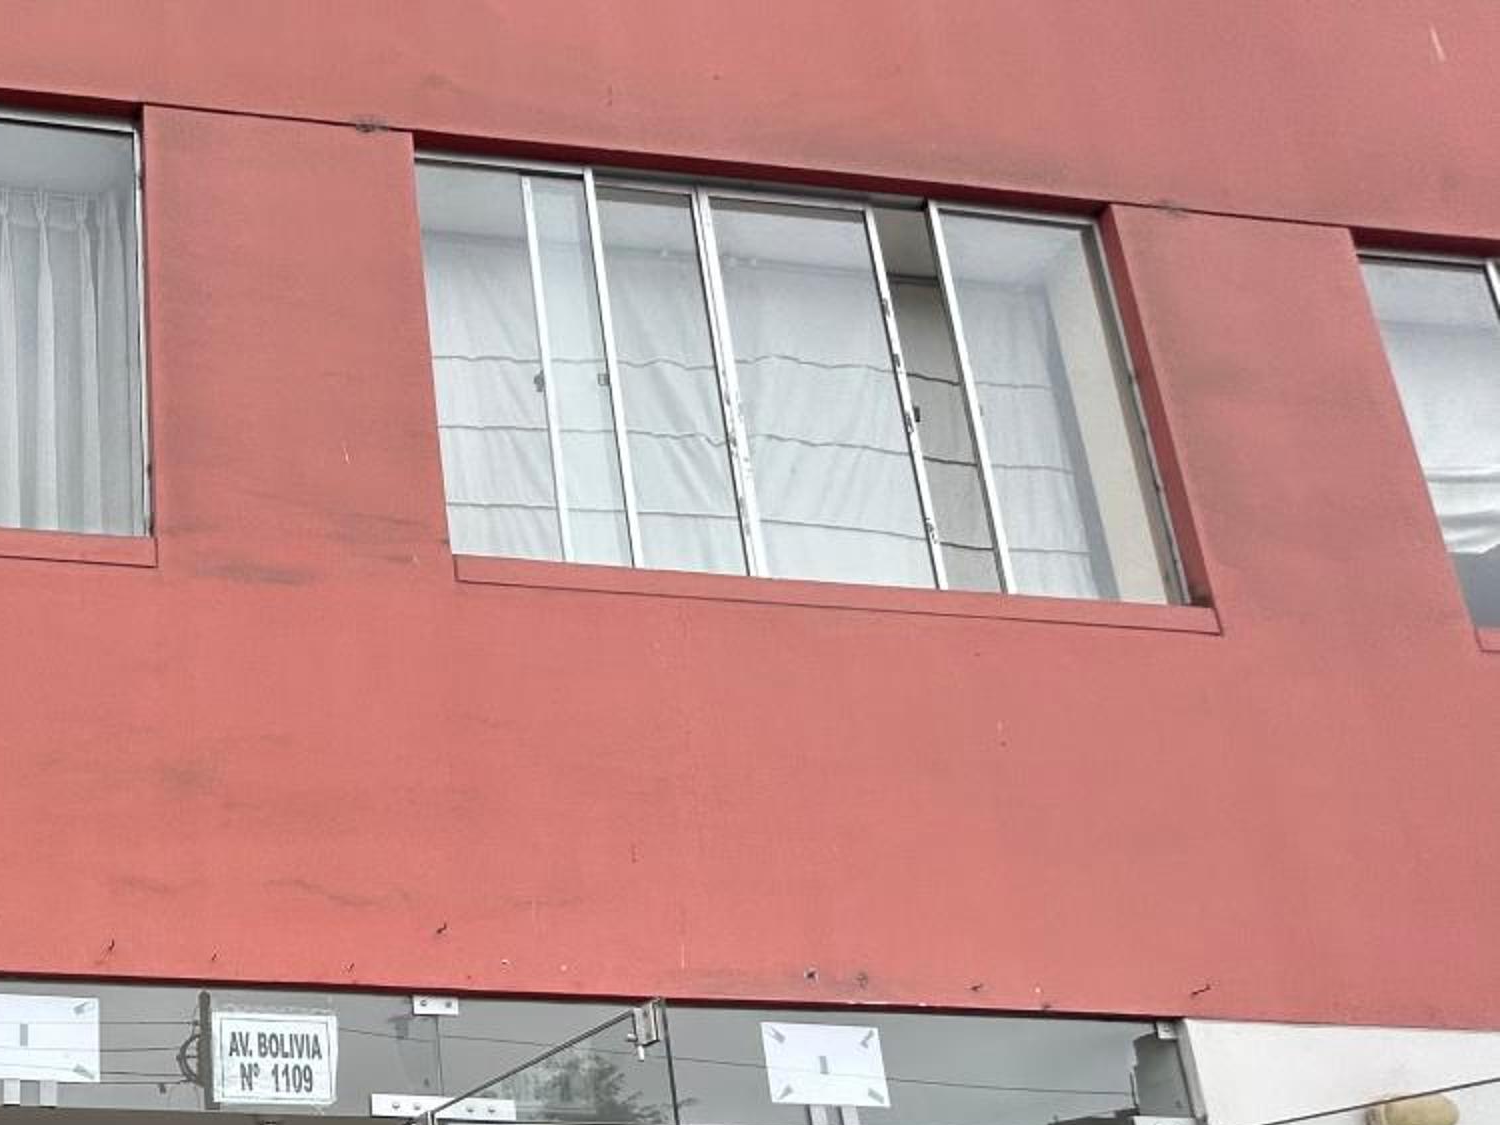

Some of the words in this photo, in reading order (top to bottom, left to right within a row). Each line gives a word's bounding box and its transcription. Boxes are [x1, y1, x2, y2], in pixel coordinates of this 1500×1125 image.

[229, 1031, 253, 1057] AV.
[257, 1032, 322, 1060] BOLIVIA
[271, 1063, 313, 1093] 1109
